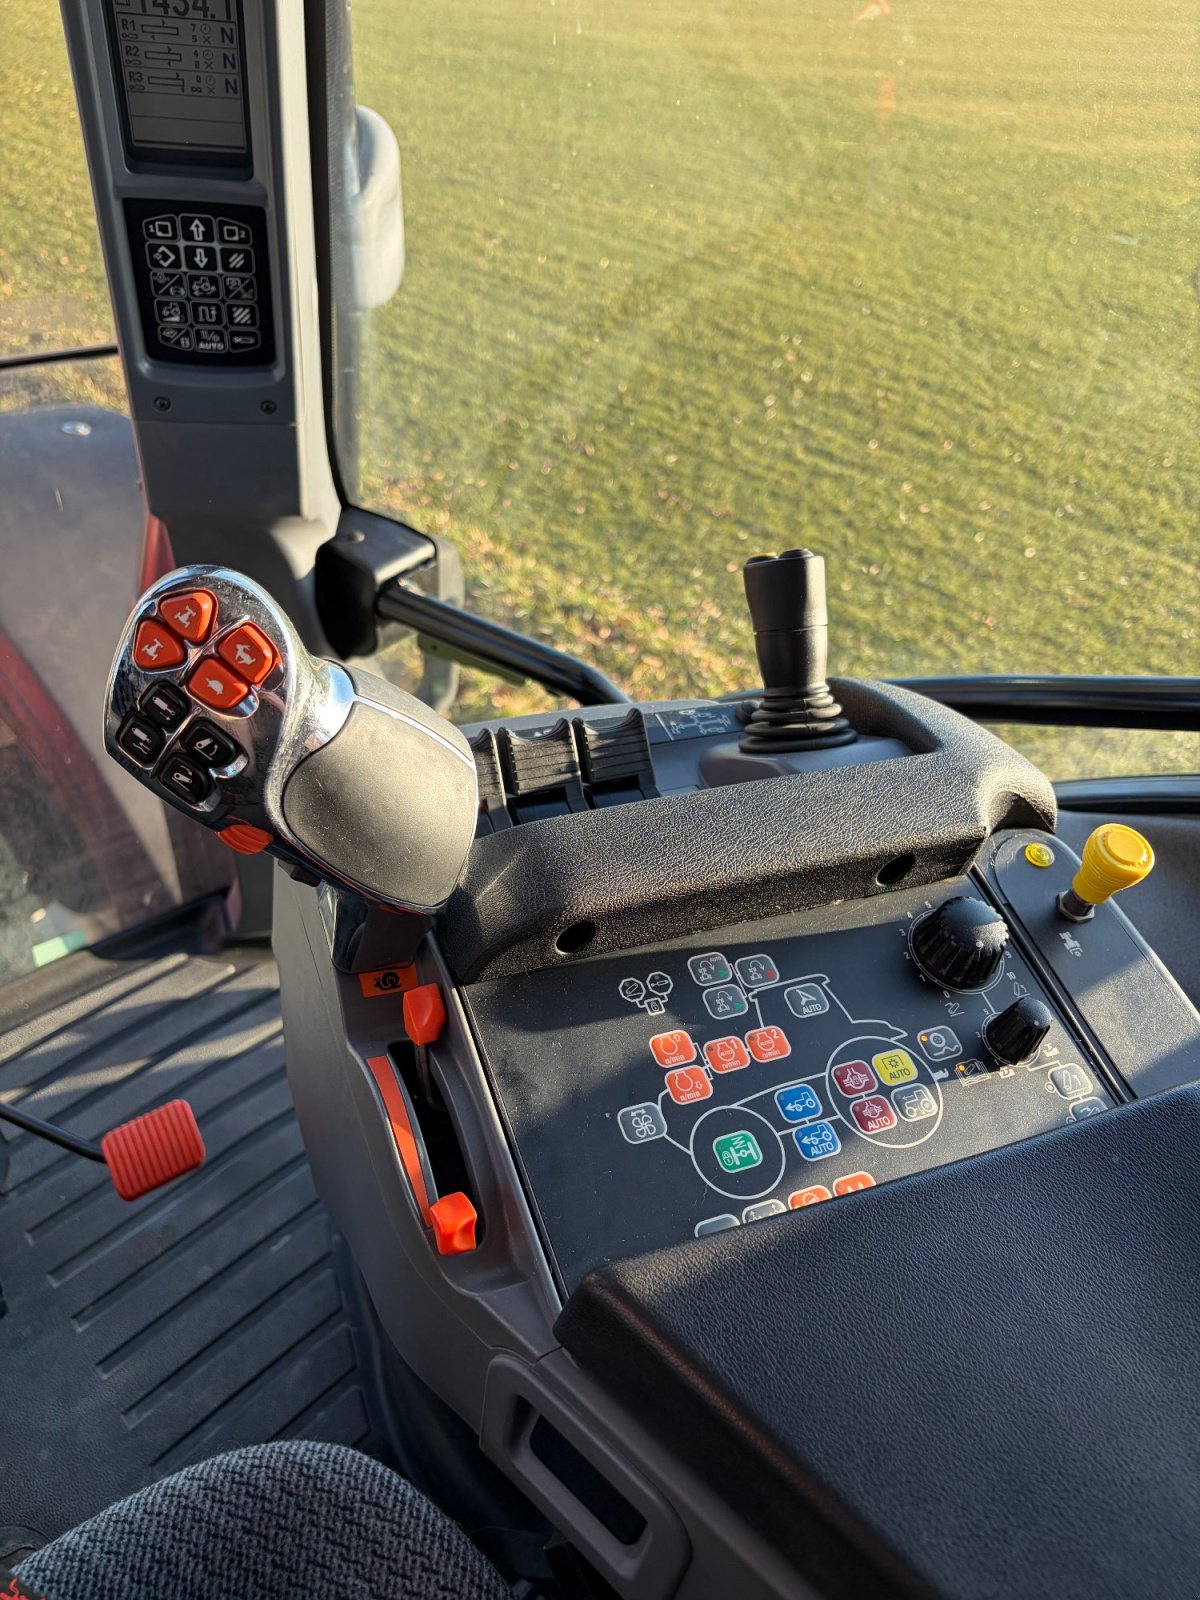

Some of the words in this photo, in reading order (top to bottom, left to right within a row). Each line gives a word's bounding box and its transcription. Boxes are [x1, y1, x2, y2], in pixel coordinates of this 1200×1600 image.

[121, 18, 136, 31] R1
[221, 27, 234, 44] N
[125, 45, 140, 57] R2
[223, 52, 236, 70] N
[128, 71, 143, 83] R3
[225, 78, 238, 95] N
[198, 341, 225, 350] AUTO
[1006, 971, 1017, 981] 10
[802, 1003, 822, 1014] AUTO
[771, 1029, 779, 1039] 2
[730, 1040, 738, 1050] 1
[664, 1055, 686, 1065] n/min
[888, 1068, 911, 1081] AUTO
[680, 1090, 701, 1101] n/min
[866, 1117, 891, 1131] AUTO
[810, 1141, 835, 1157] AUTO
